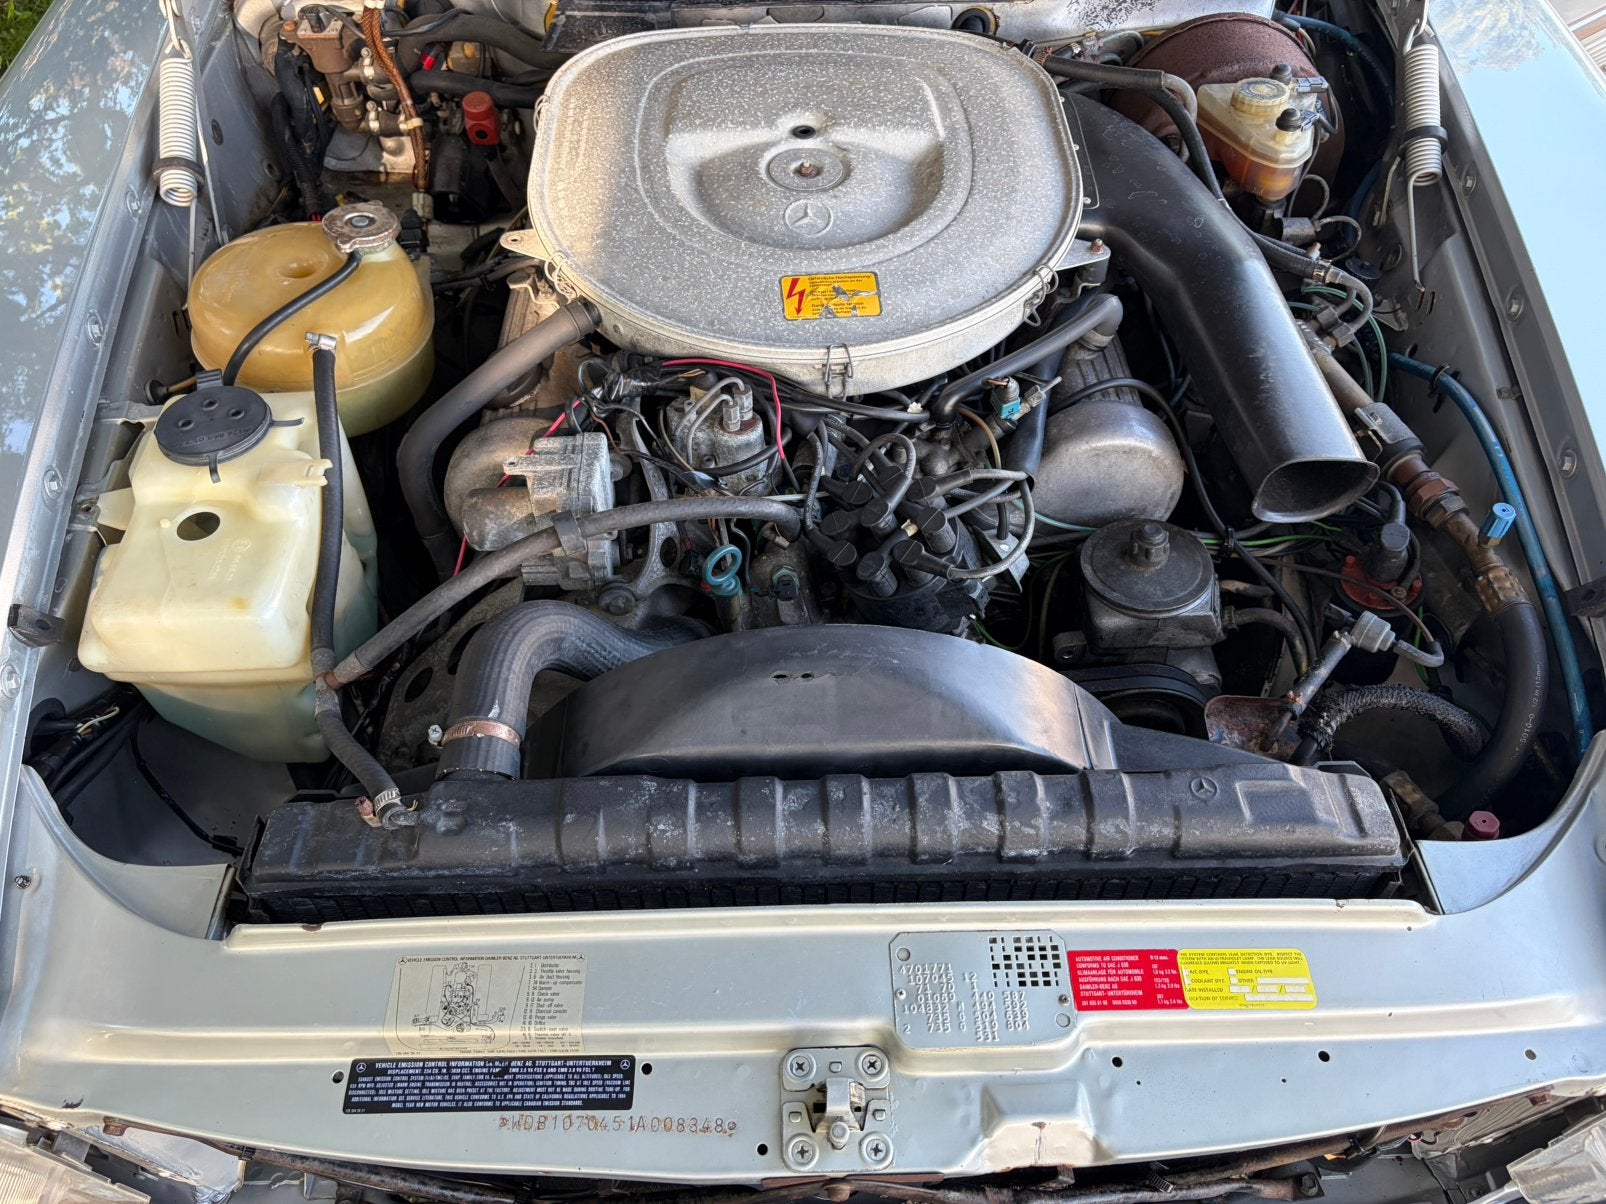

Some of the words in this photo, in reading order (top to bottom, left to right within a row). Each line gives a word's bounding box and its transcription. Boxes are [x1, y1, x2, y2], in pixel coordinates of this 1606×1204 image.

[900, 963, 952, 974] 4701771
[908, 973, 954, 984] 107045
[964, 972, 977, 982] 12
[916, 984, 932, 993] 71
[940, 982, 955, 992] 70
[971, 981, 978, 991] 1
[972, 991, 994, 1000] 440
[1003, 991, 1025, 1000] 587
[904, 1003, 949, 1014] 104832
[973, 1000, 996, 1010] 494
[1004, 1000, 1027, 1010] 592
[927, 1012, 950, 1023] 735
[974, 1010, 997, 1021] 504
[904, 1024, 911, 1033] 2
[928, 1022, 951, 1033] 735
[975, 1021, 998, 1031] 519
[1007, 1020, 1029, 1030] 804
[976, 1031, 999, 1041] 531
